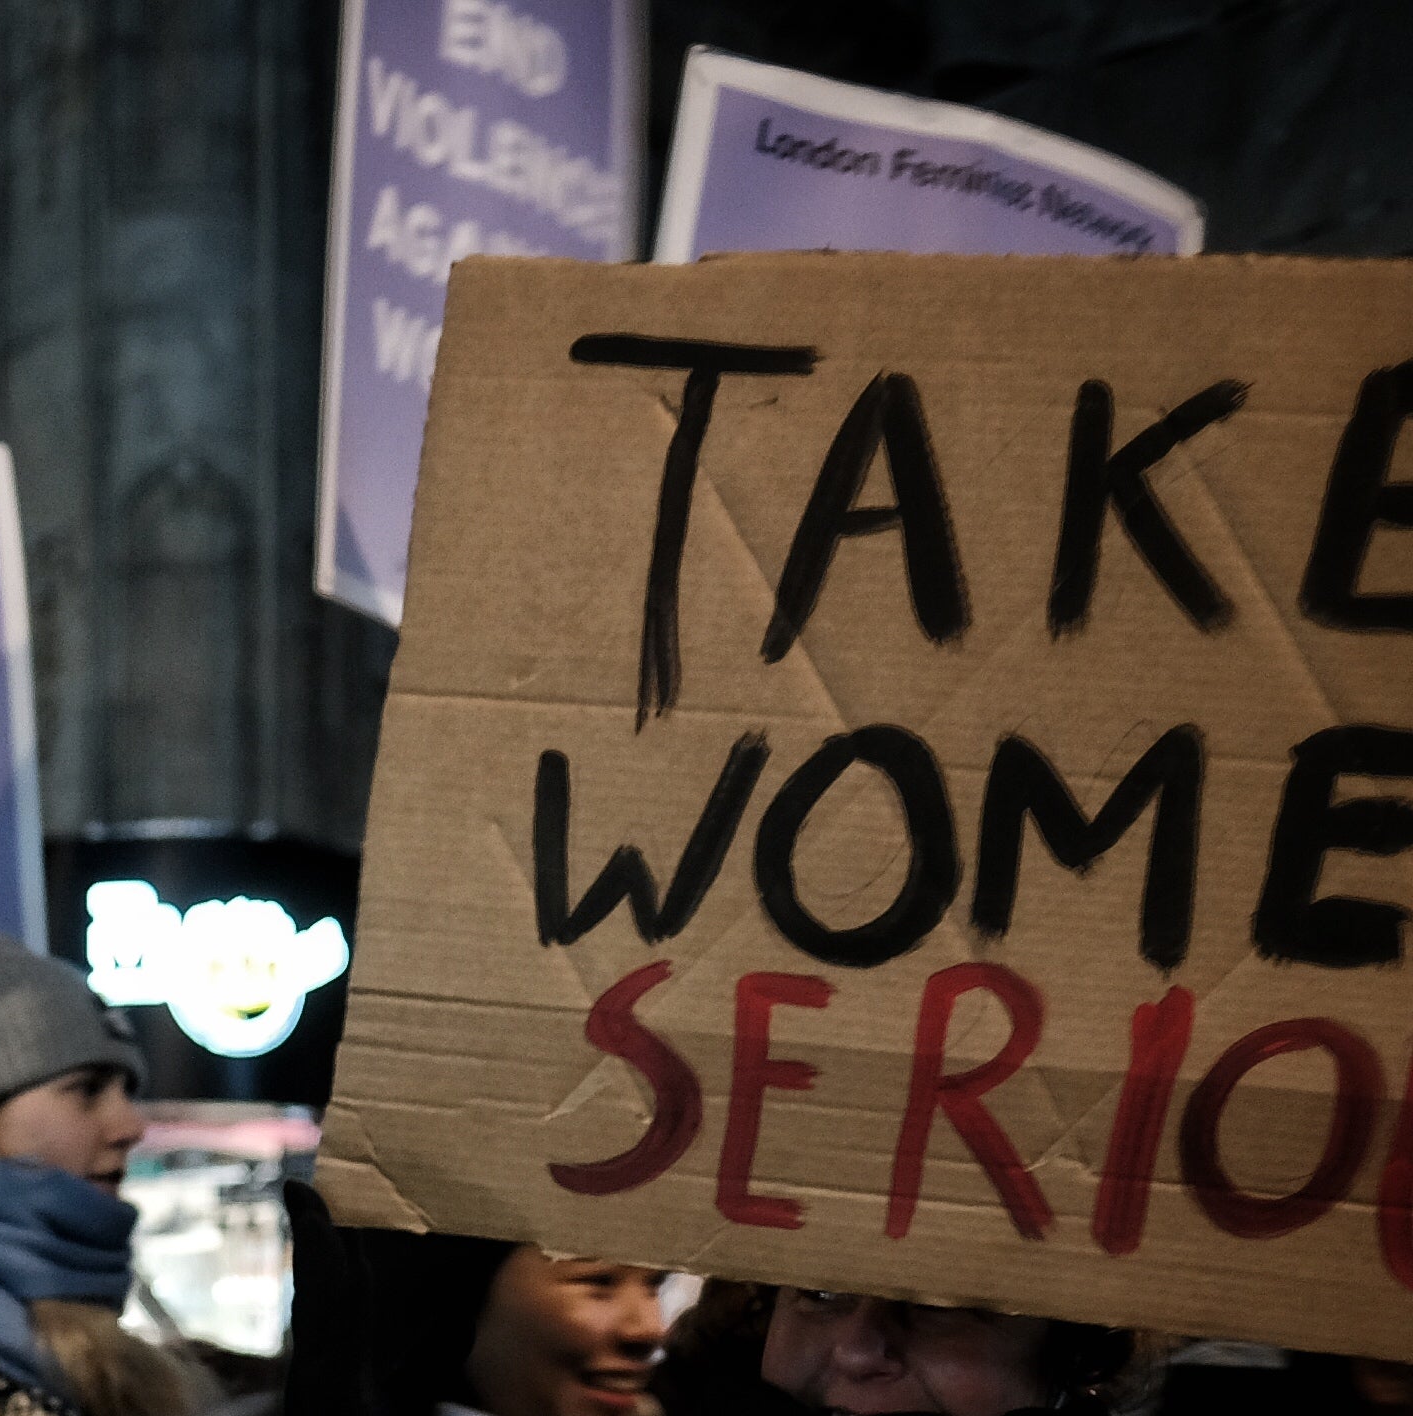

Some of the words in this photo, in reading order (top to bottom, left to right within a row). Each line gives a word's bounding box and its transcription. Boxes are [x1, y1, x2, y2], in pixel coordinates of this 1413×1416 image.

[755, 117, 881, 177] London
[568, 333, 1413, 734] TAKE
[532, 723, 1413, 977] WOME
[547, 960, 1413, 1287] SERIO
